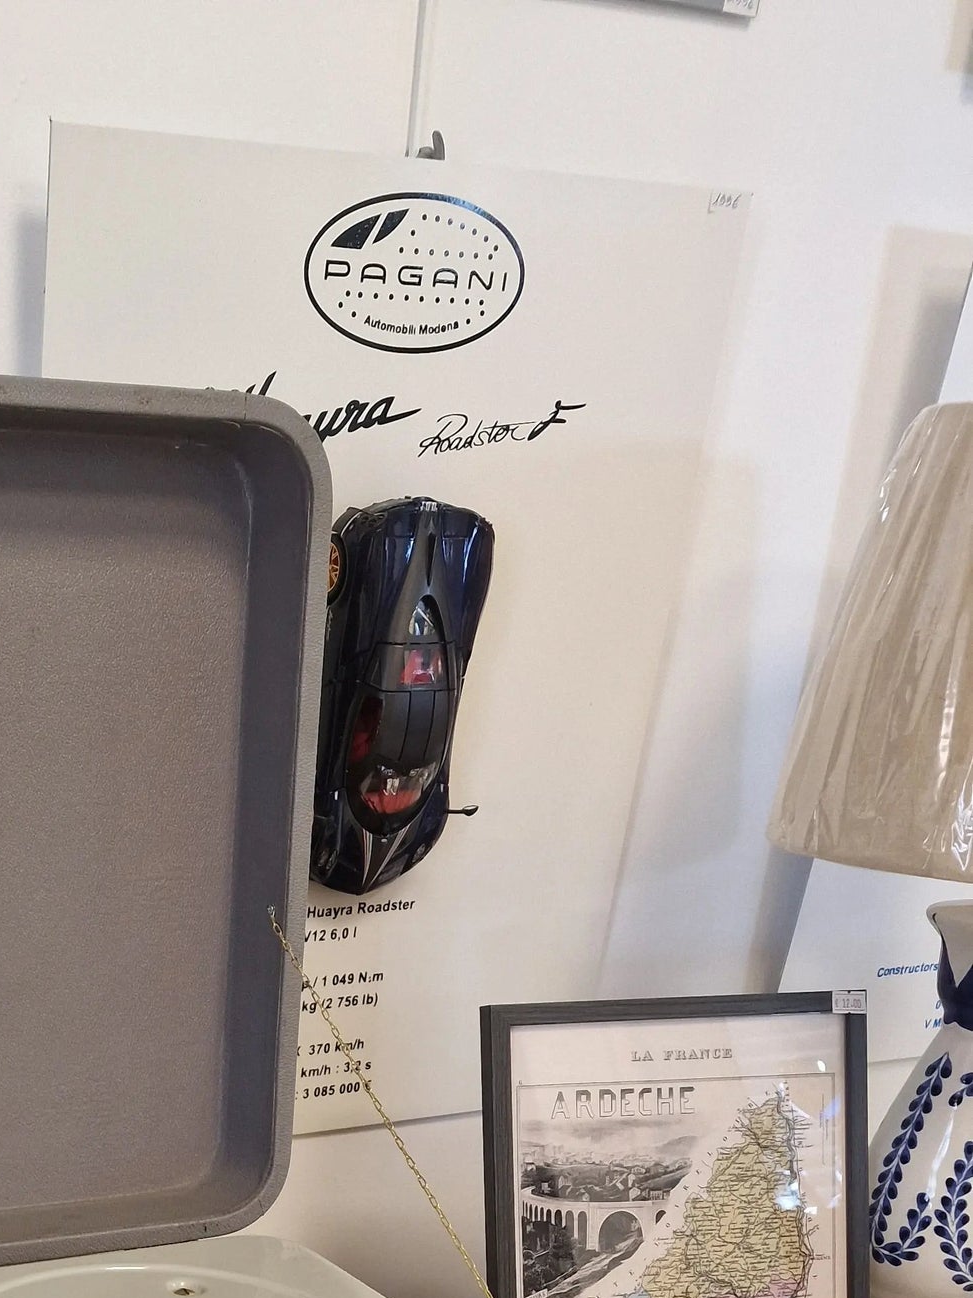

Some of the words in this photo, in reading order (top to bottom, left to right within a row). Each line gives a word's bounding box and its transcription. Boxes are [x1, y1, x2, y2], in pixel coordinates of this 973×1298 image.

[323, 259, 508, 292] PAGANI
[419, 321, 459, 335] Modena
[307, 906, 353, 919] Huayra
[357, 900, 415, 914] Roadster
[330, 928, 348, 941] 6,0
[877, 963, 939, 977] Constructors
[332, 973, 354, 986] 049
[301, 1001, 317, 1014] kg
[337, 995, 359, 1008] 756
[362, 992, 378, 1007] lb)
[308, 1043, 330, 1055] 370
[631, 1050, 654, 1062] LA
[663, 1048, 733, 1061] FRANCE
[301, 1065, 331, 1078] km/h
[302, 1088, 309, 1099] 3
[314, 1085, 335, 1097] 085
[339, 1082, 360, 1094] 000
[551, 1086, 695, 1119] ARDECHE
